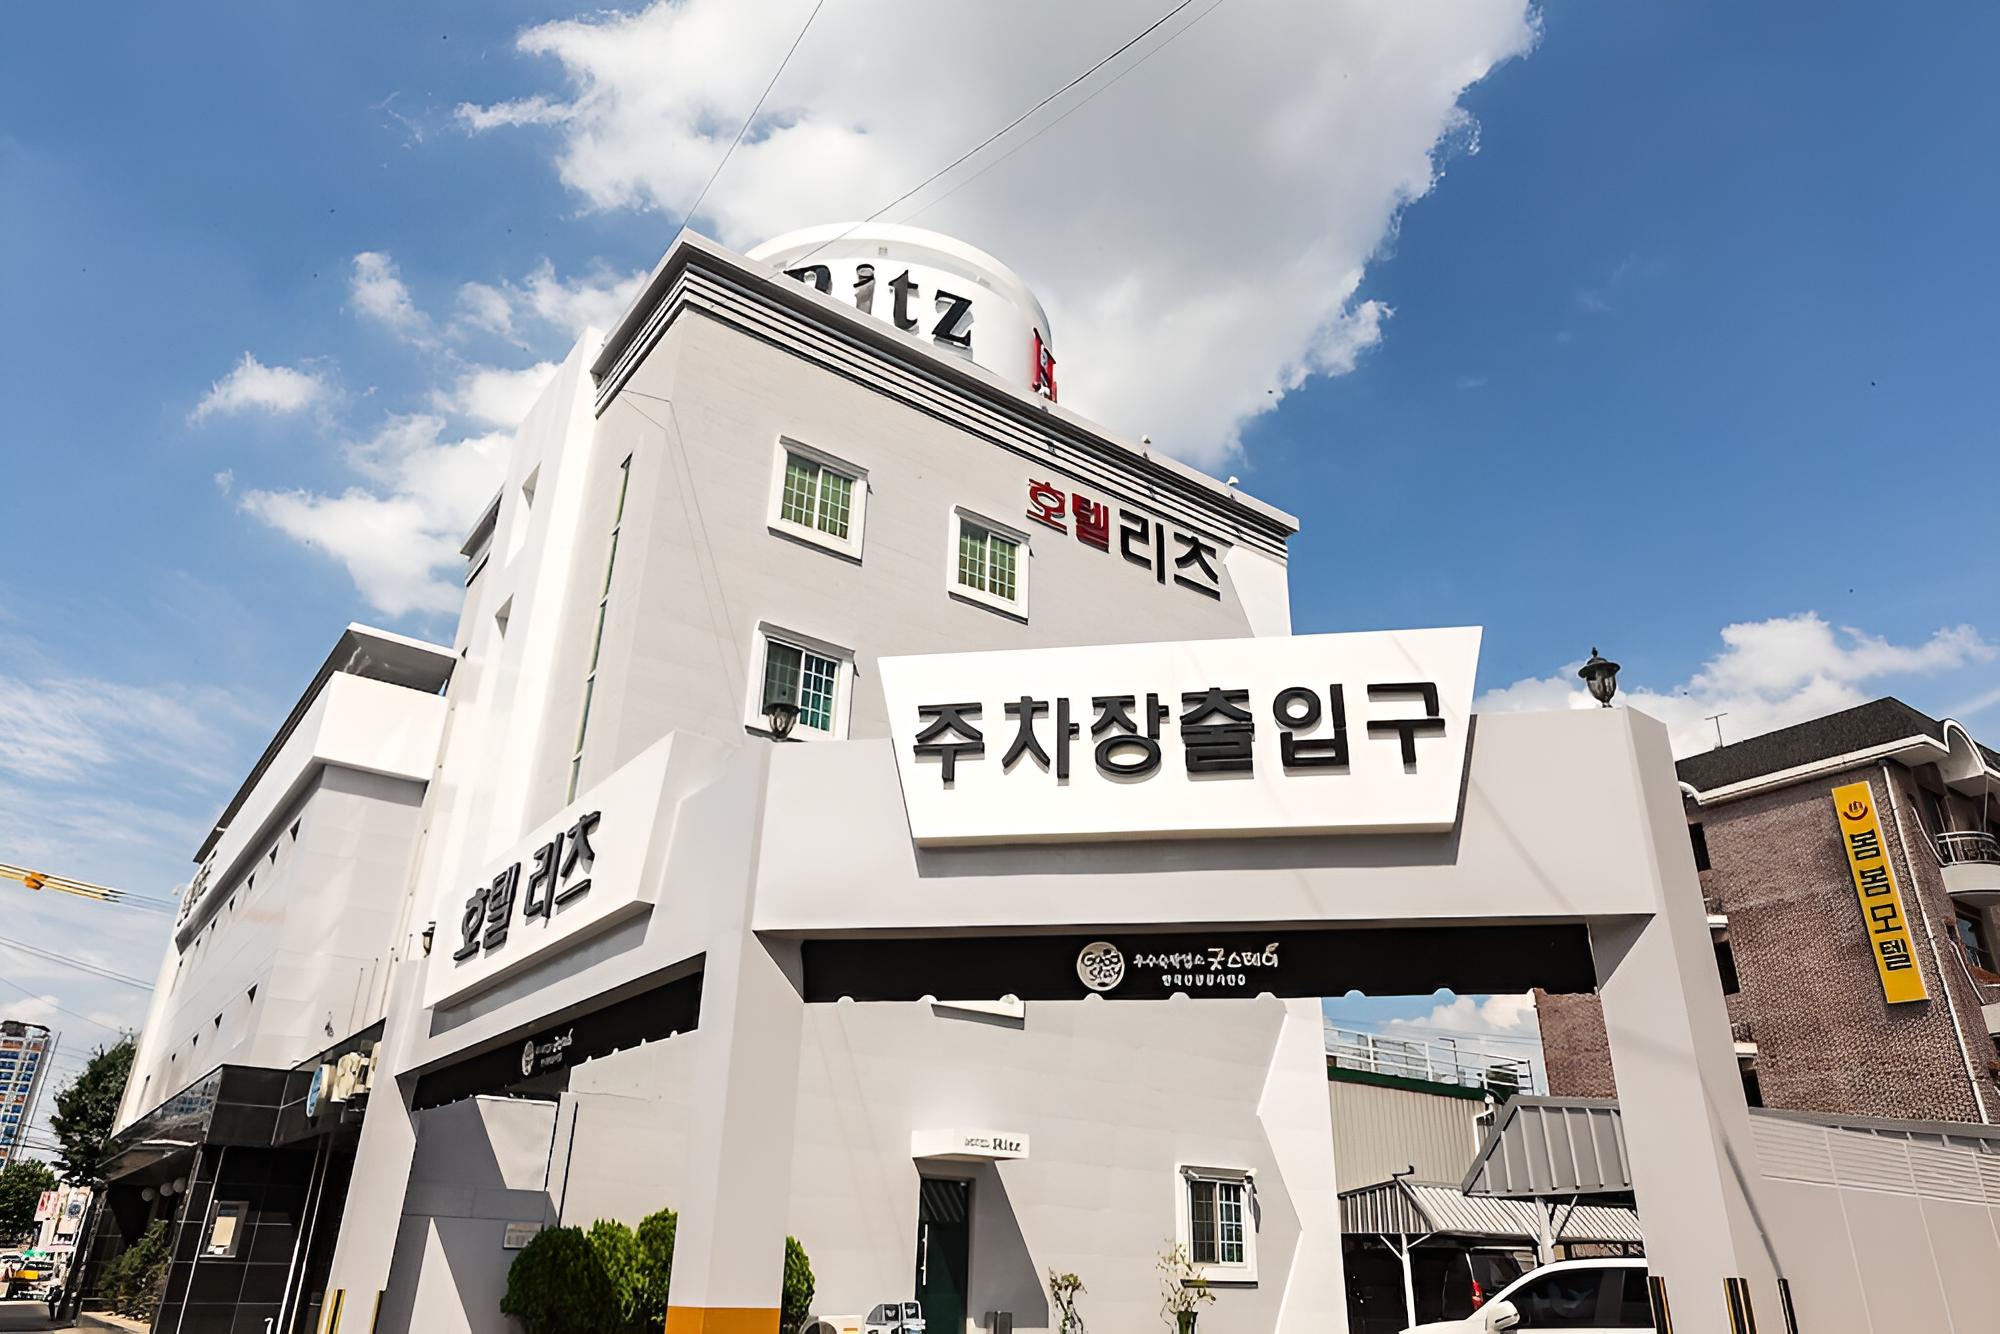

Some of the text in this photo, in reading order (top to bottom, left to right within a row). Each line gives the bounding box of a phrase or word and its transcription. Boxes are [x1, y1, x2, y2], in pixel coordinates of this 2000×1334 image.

[1026, 478, 1110, 554] 호텔
[913, 682, 1446, 783] 주차장출입구
[453, 862, 521, 961] 호텔
